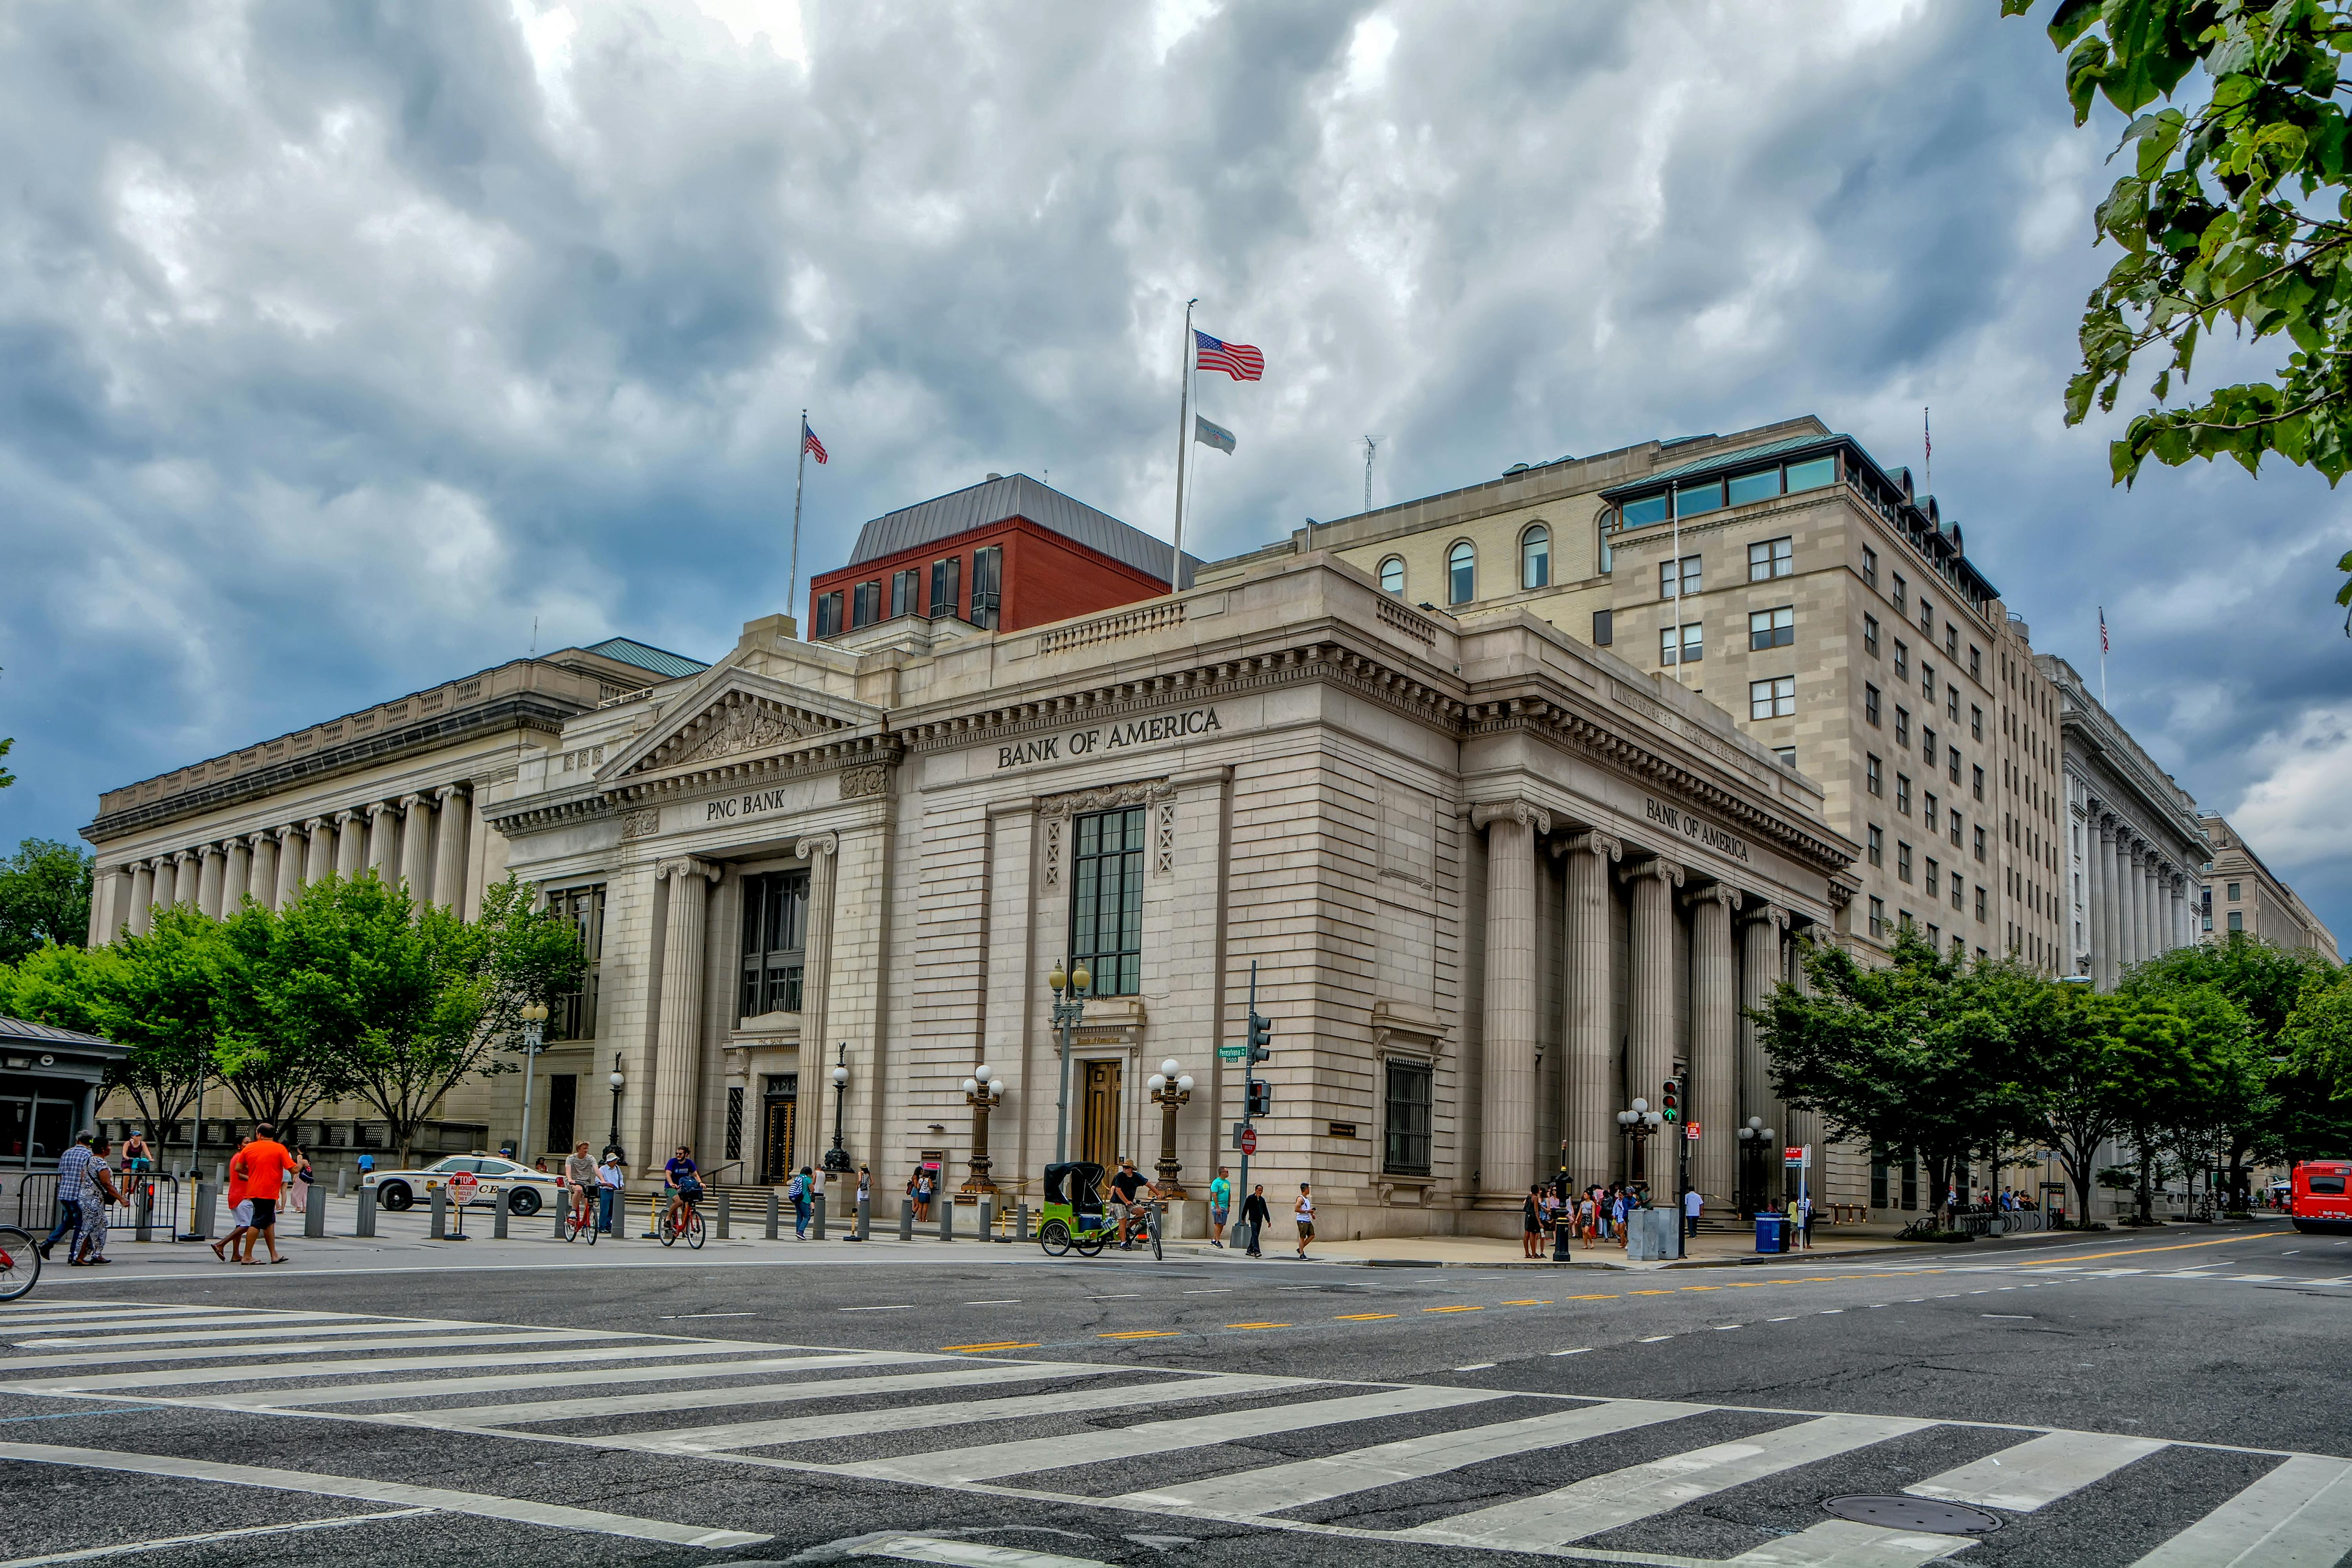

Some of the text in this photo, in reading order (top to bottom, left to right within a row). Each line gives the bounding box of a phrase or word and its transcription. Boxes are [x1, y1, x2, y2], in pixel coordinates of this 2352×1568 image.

[997, 706, 1222, 768] BANK OF AMERICA
[1619, 689, 1672, 727] INCORPORATED
[1717, 744, 1743, 768] ERECTED
[707, 789, 785, 821] PNC BANK
[1646, 797, 1749, 862] BANK OF AMERICA
[770, 1037, 784, 1045] BANK
[1220, 1048, 1240, 1057] Pennsylvania
[454, 1176, 473, 1184] STOP
